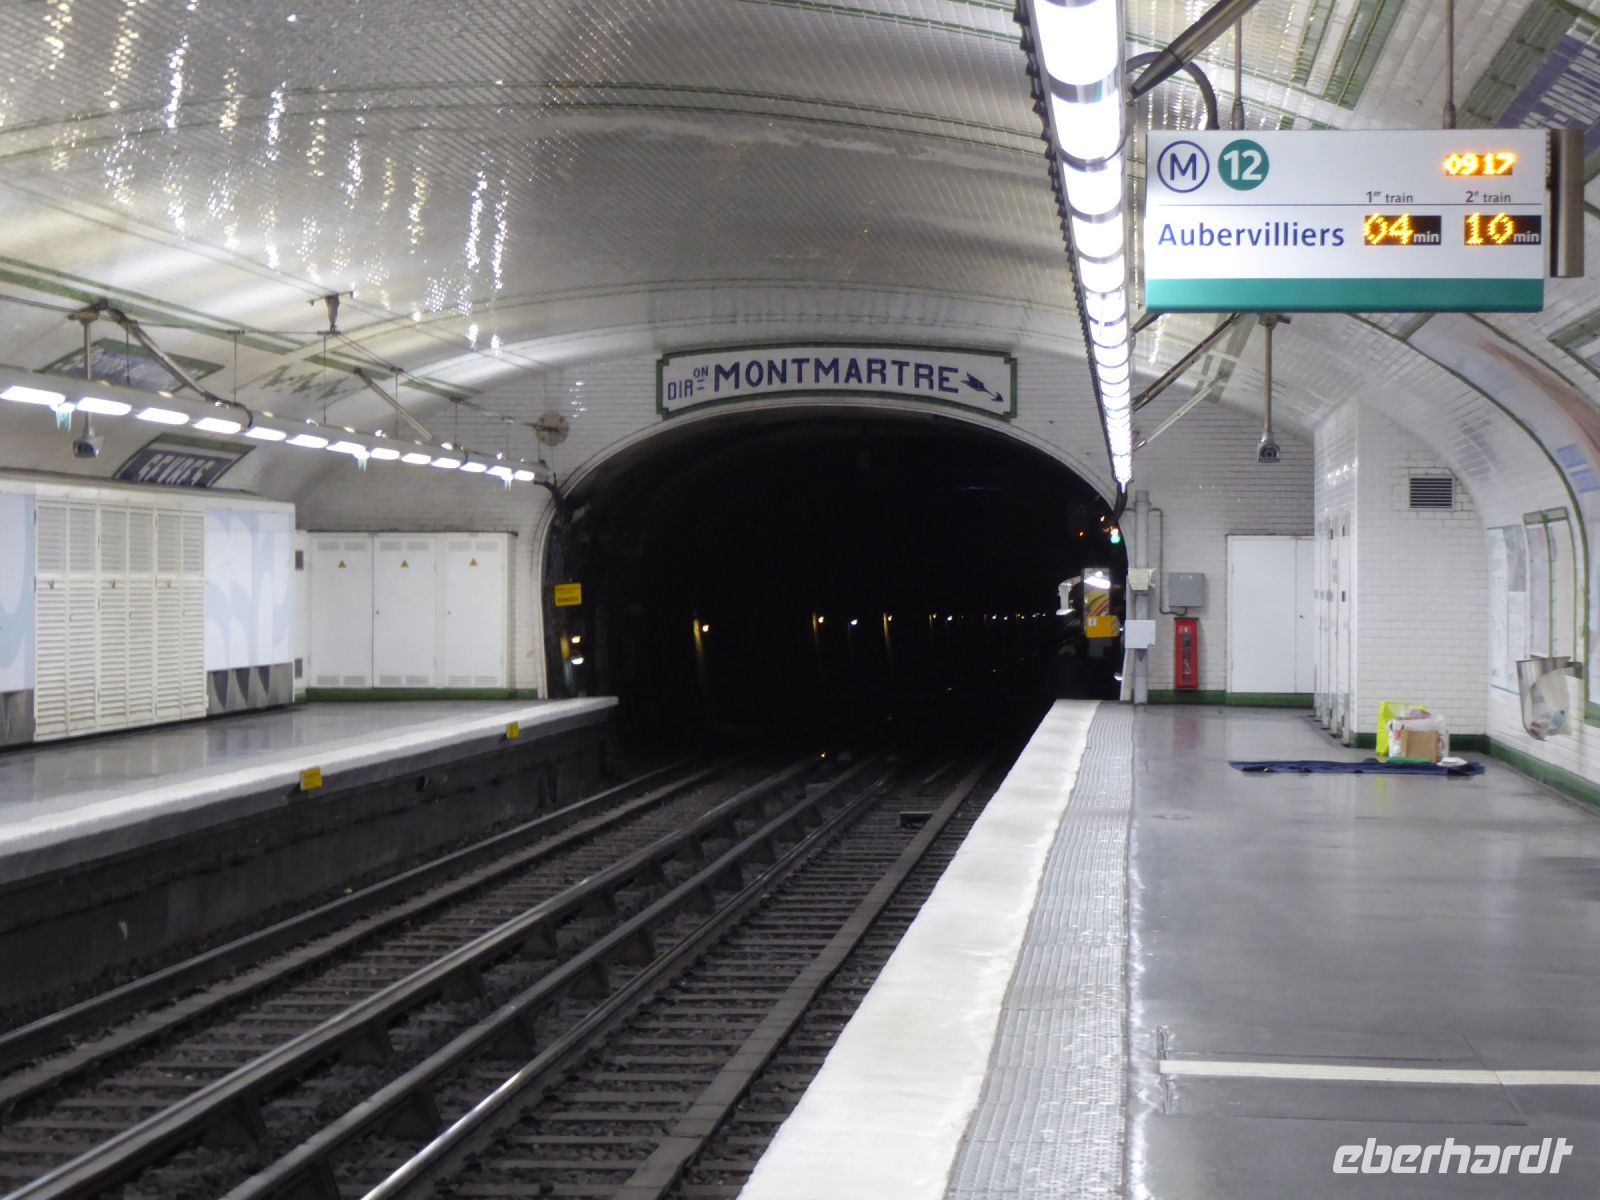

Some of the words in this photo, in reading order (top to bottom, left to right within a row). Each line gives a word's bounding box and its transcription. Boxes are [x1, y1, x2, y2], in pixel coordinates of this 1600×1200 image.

[1170, 152, 1197, 181] M
[1223, 149, 1262, 181] 12
[1444, 153, 1479, 176] 09
[1482, 152, 1517, 176] 17
[1366, 190, 1383, 204] 1er
[1385, 192, 1414, 204] train
[1465, 190, 1480, 204] 2e
[1482, 192, 1512, 204] train
[1158, 221, 1345, 247] Aubervilliers
[1362, 212, 1414, 245] 04
[1413, 230, 1440, 244] min
[1465, 212, 1515, 245] 10
[1513, 230, 1540, 243] min
[714, 357, 959, 394] MONTMARTRE
